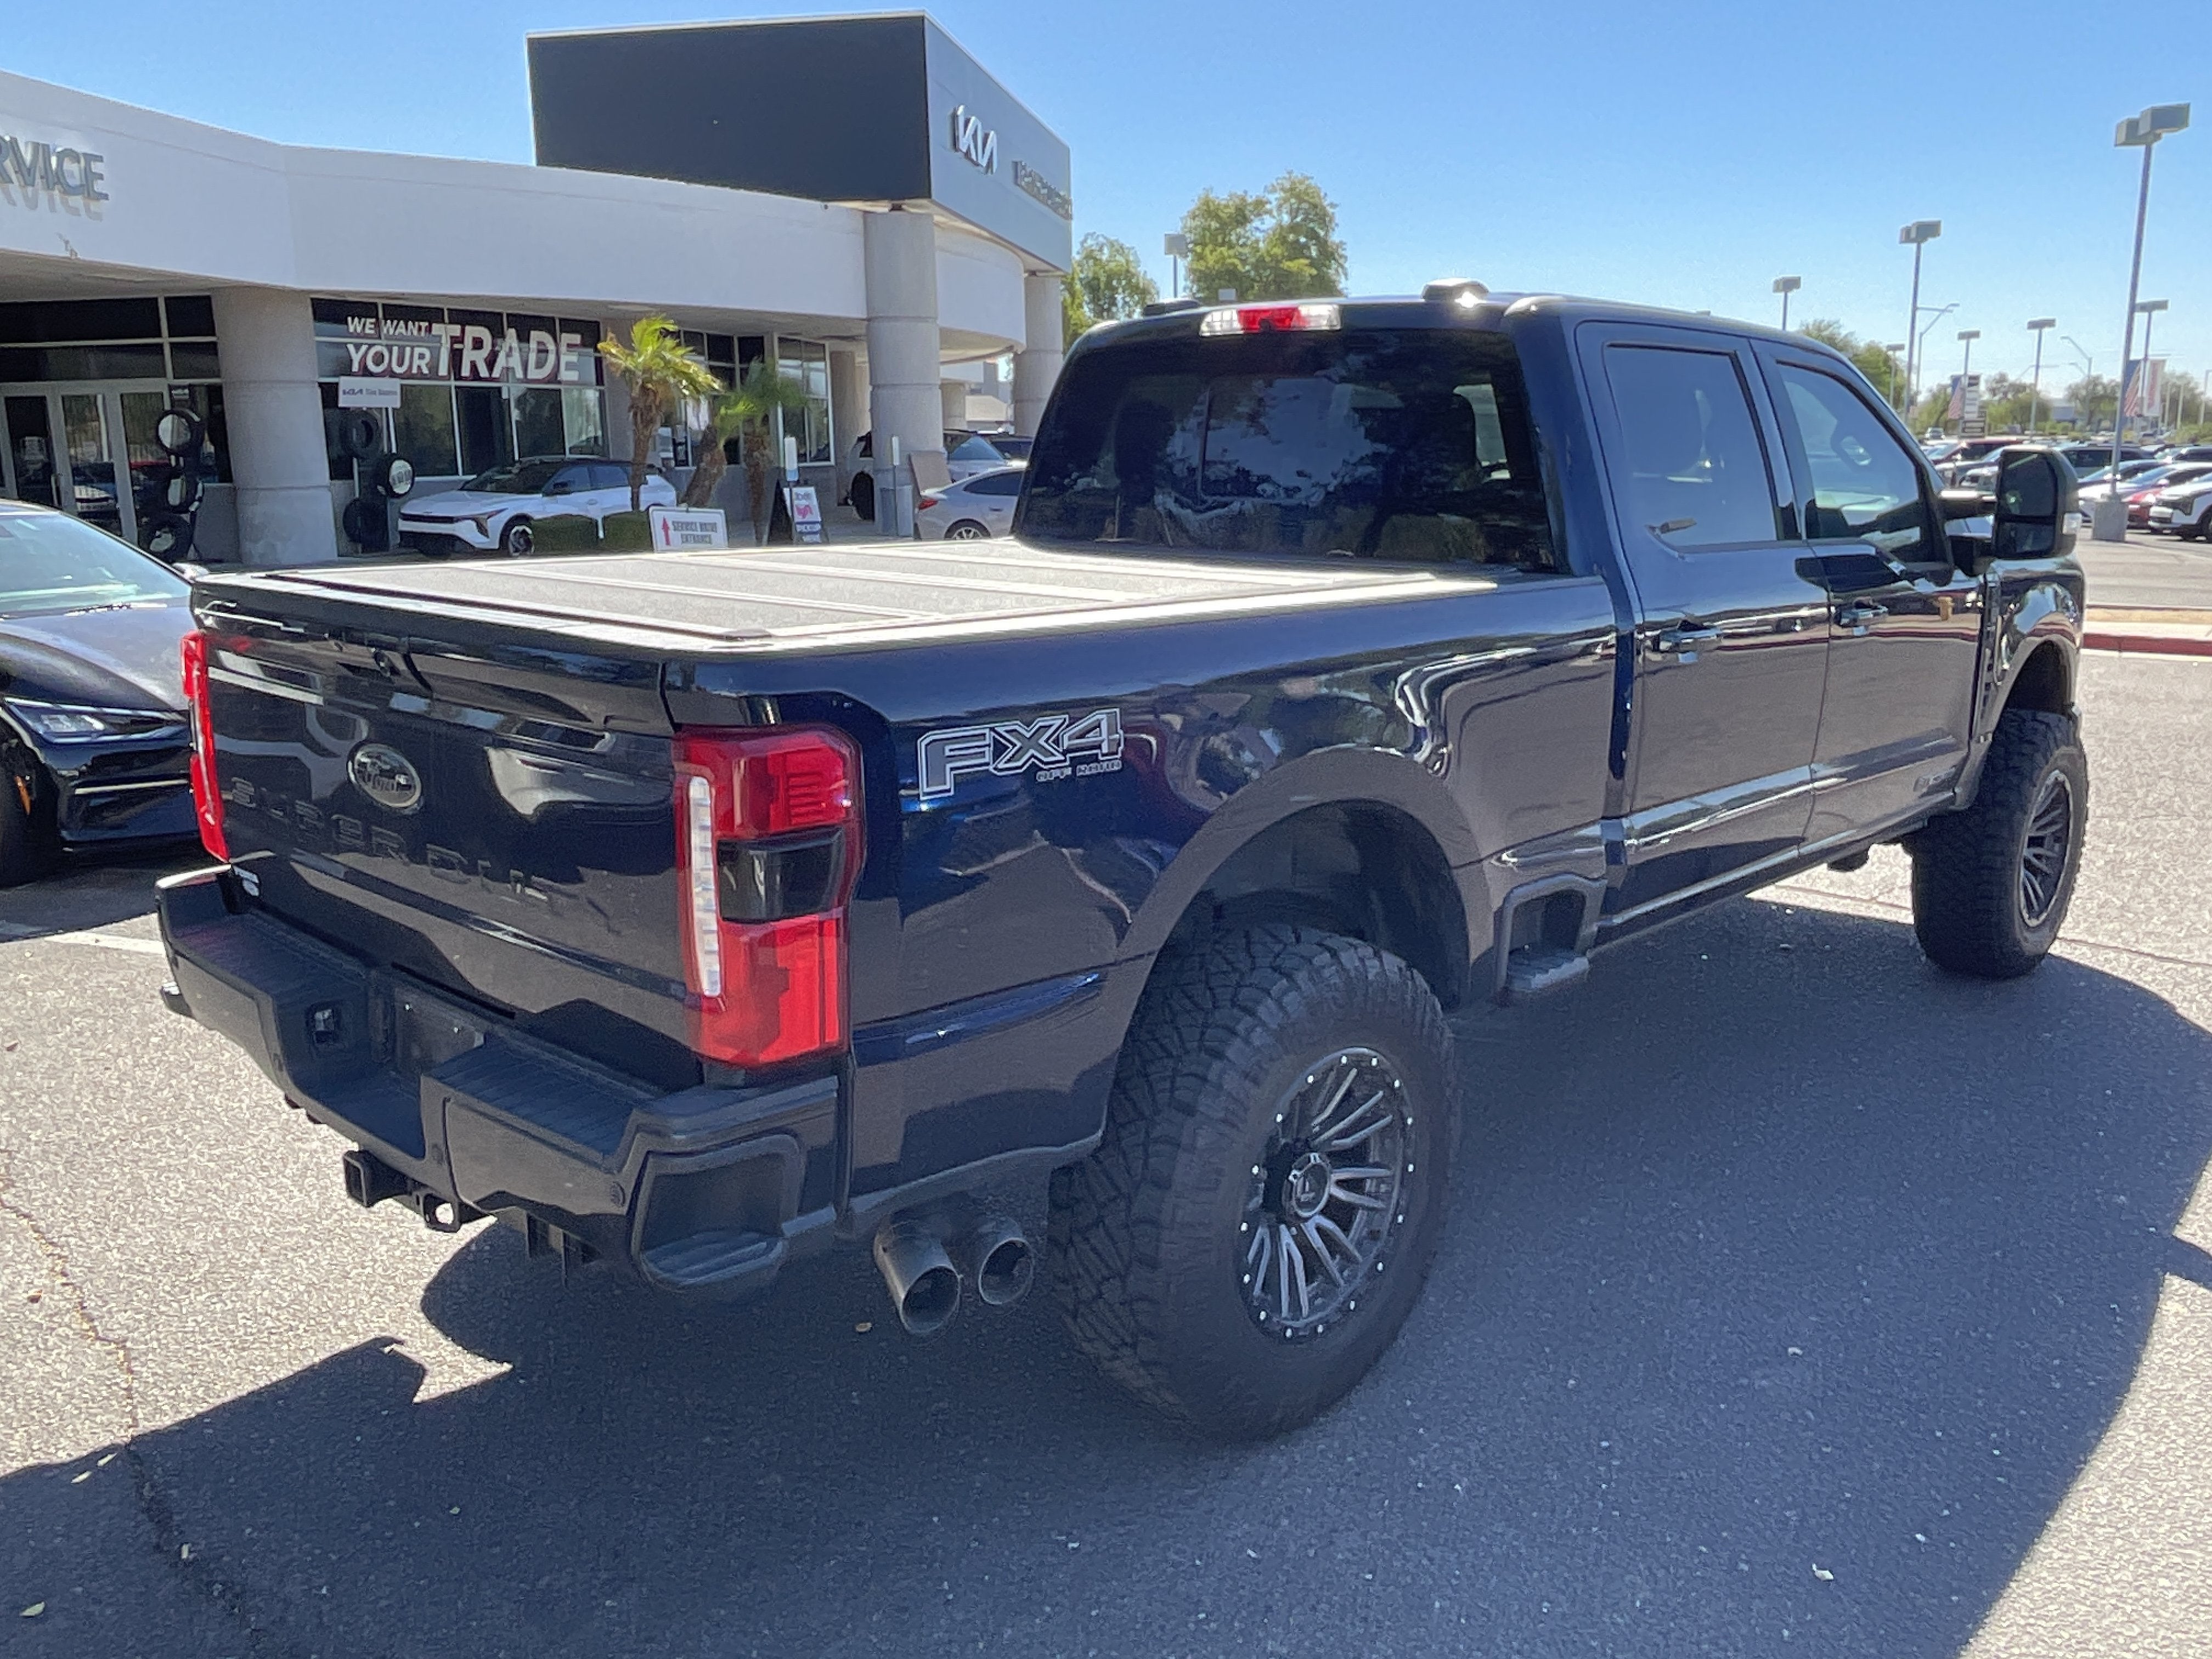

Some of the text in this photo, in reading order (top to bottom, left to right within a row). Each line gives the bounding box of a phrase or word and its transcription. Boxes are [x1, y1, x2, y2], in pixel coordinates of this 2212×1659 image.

[346, 323, 582, 381] YOUR TRADE
[347, 316, 430, 336] WE WANT
[917, 708, 1125, 800] FX4
